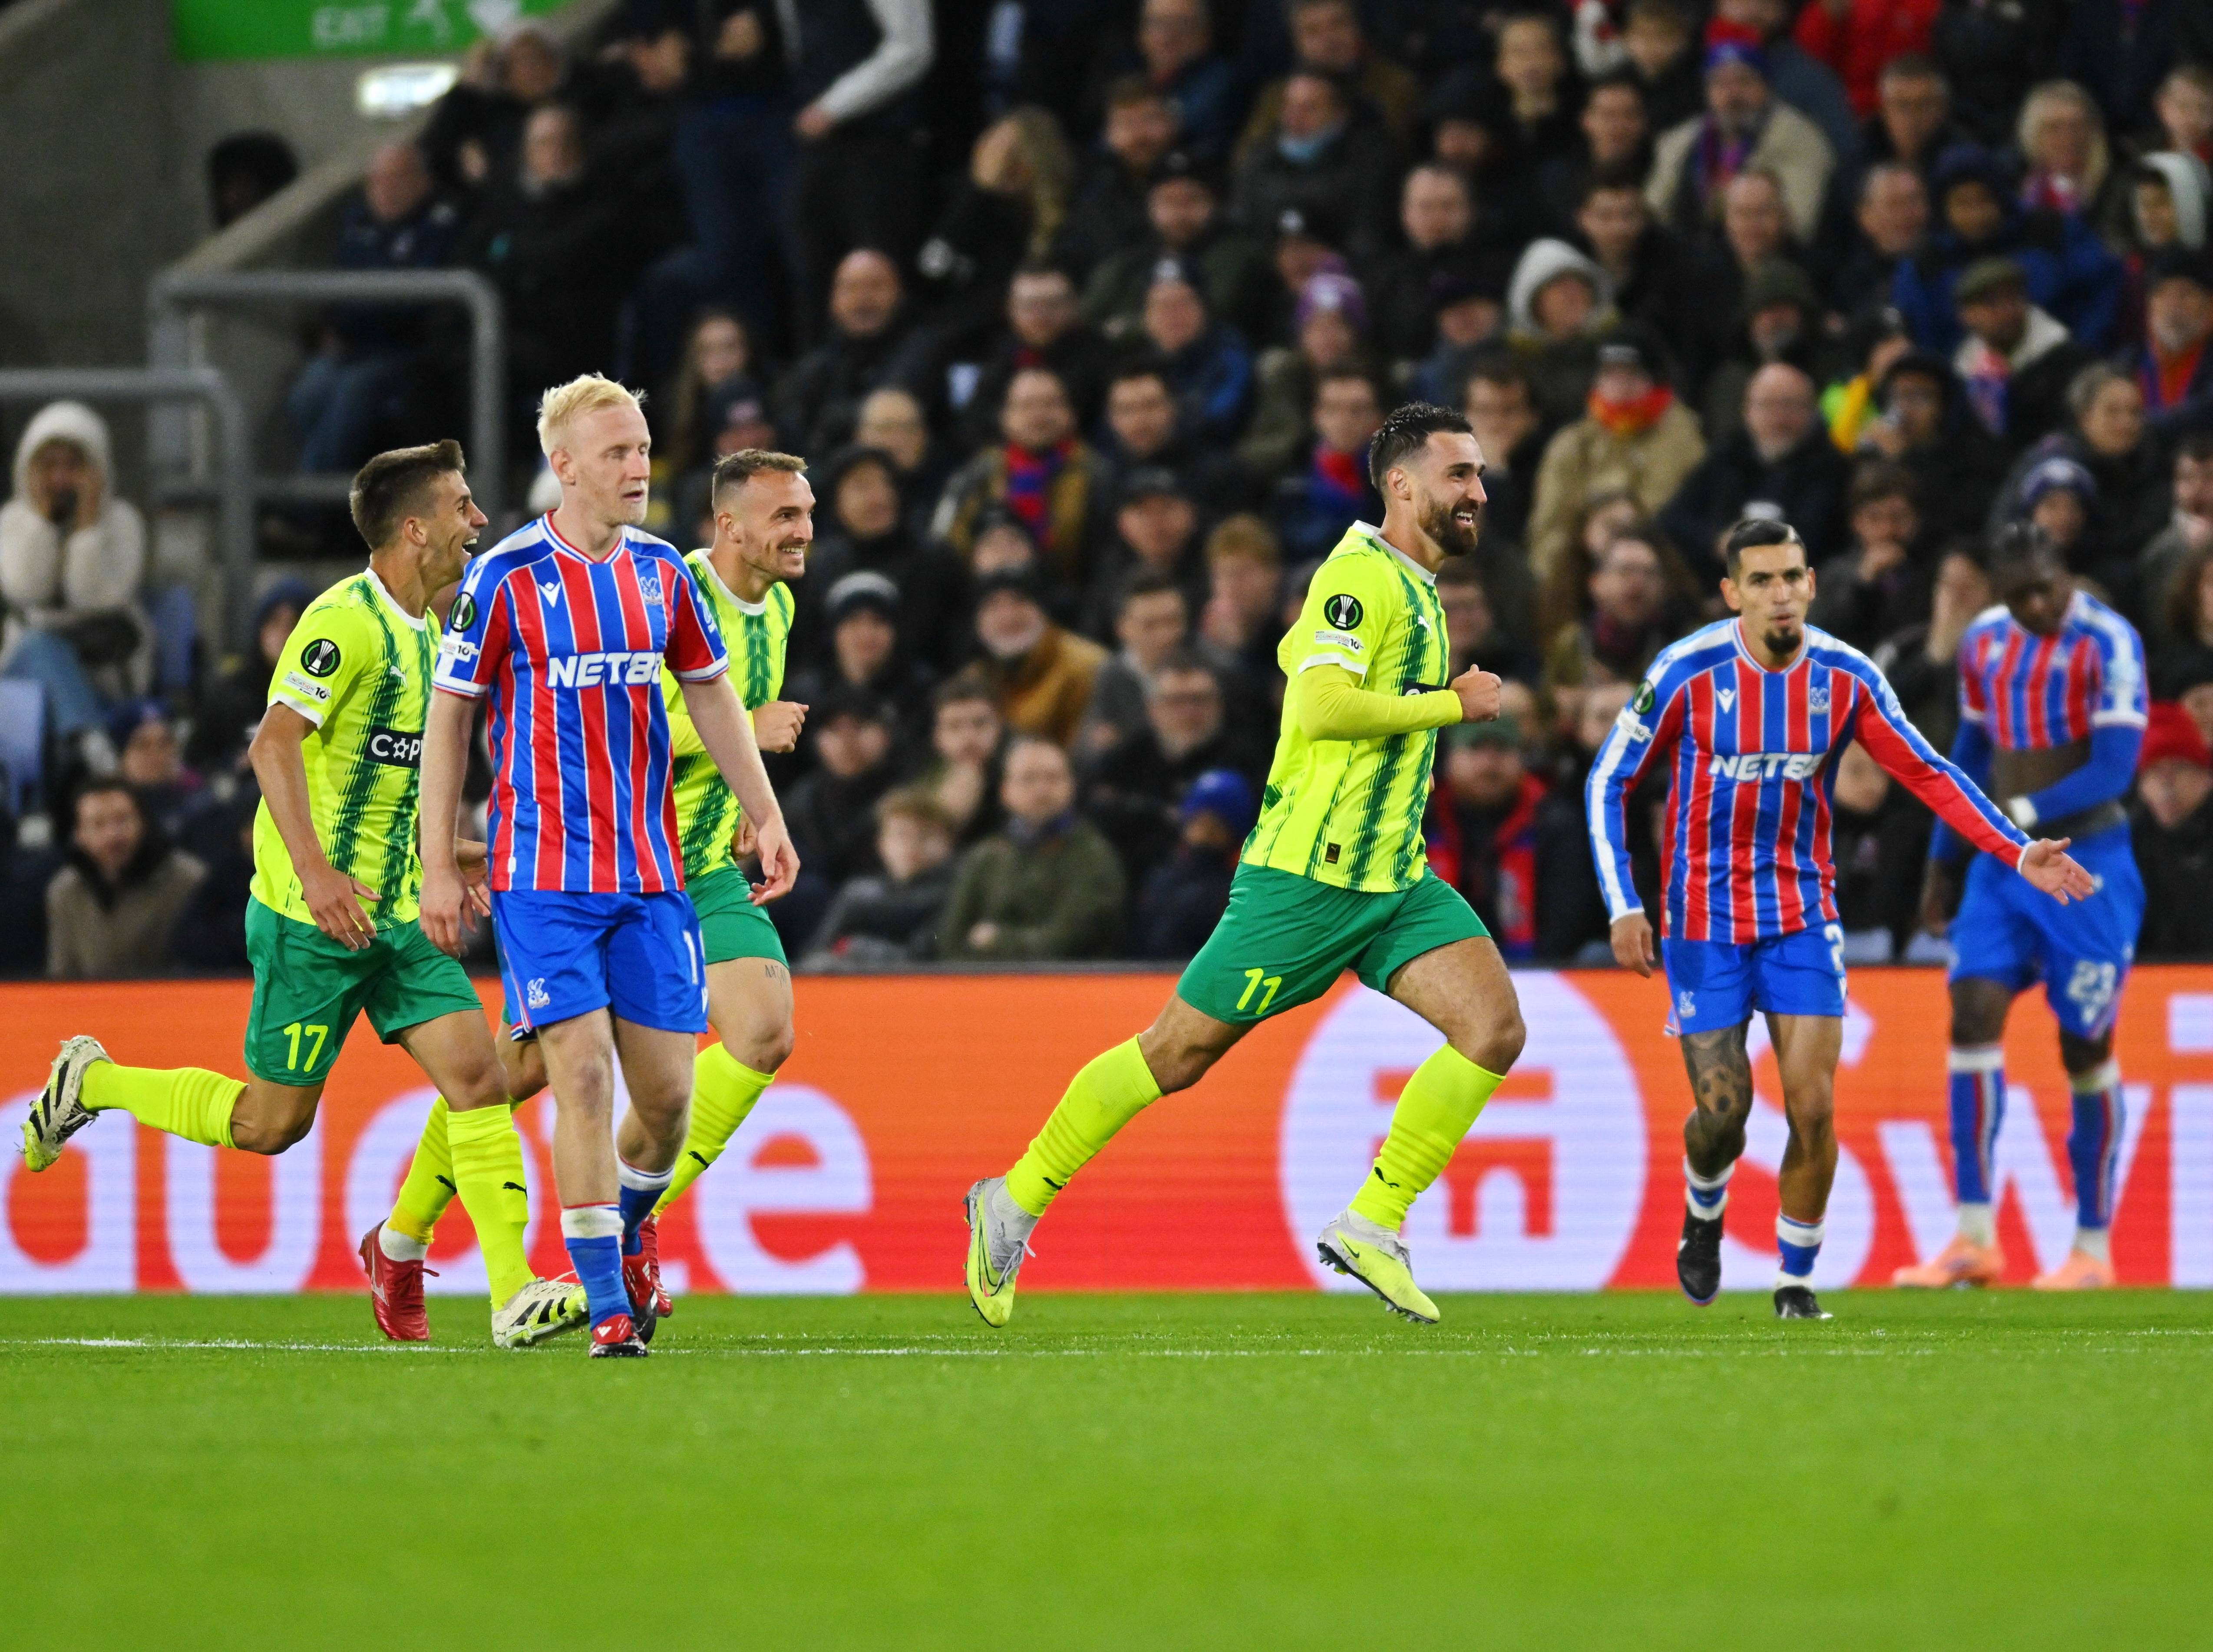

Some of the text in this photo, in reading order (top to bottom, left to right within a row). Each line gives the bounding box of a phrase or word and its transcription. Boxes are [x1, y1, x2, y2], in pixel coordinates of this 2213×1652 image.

[1237, 968, 1282, 1014] 11
[2067, 961, 2116, 1002] 23
[284, 1022, 328, 1072] 17
